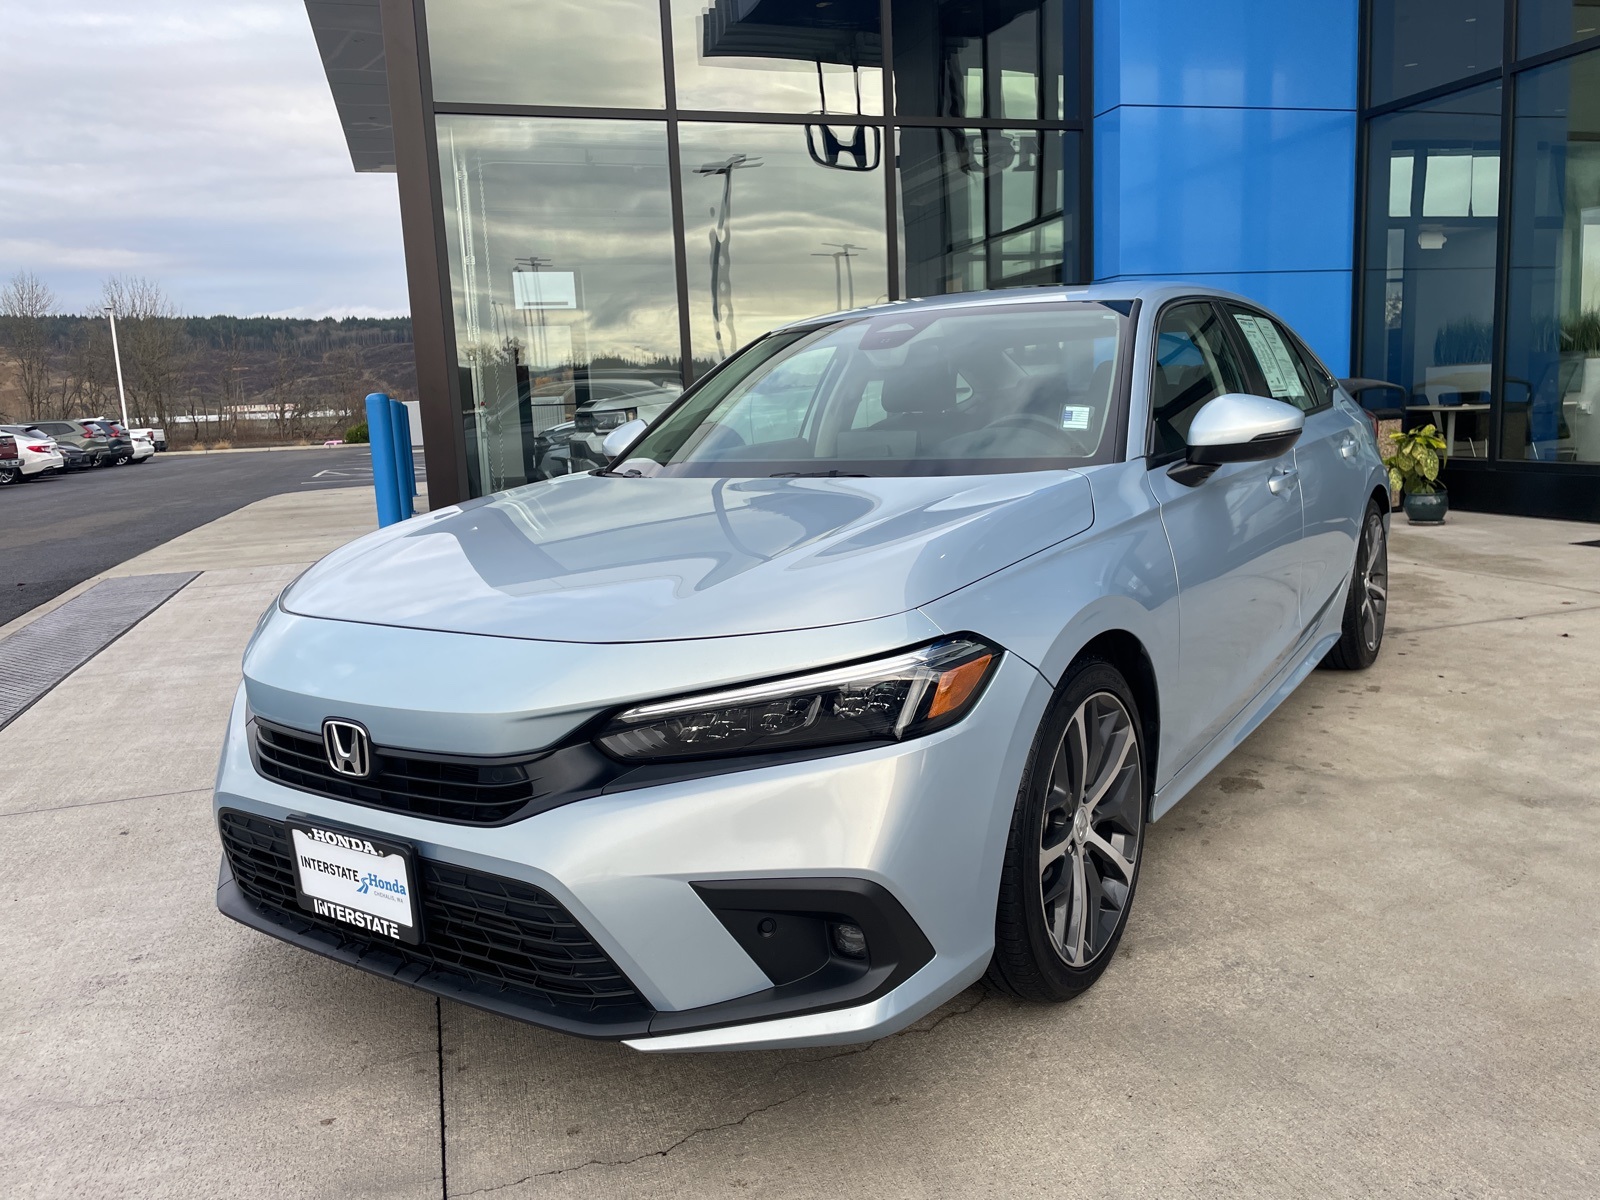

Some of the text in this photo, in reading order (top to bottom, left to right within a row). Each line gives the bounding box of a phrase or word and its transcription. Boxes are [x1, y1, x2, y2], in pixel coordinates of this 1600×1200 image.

[311, 828, 378, 855] HONDA
[300, 855, 407, 895] INTERSTATE Honda
[313, 898, 400, 940] INTERSTATE
